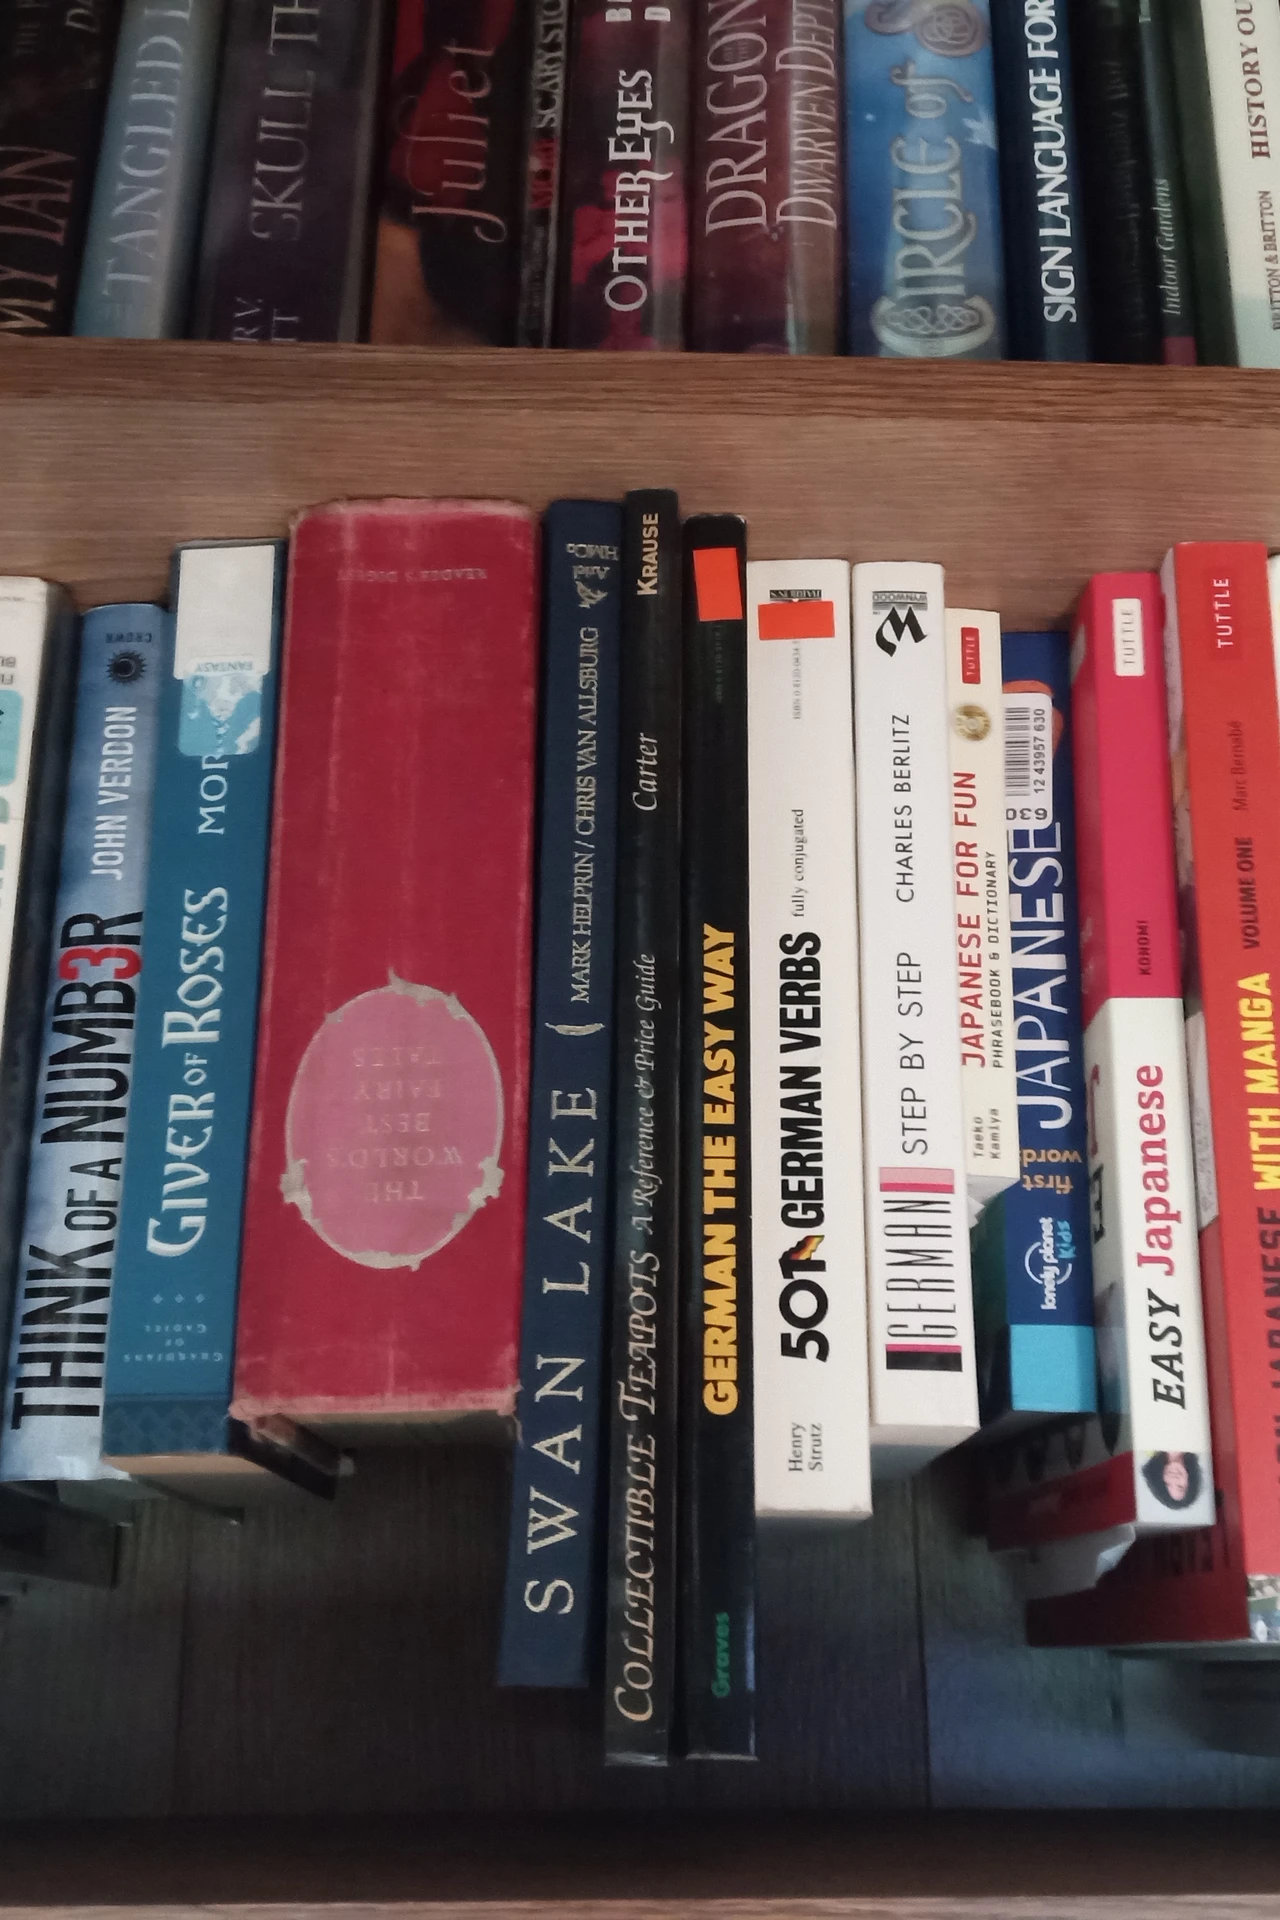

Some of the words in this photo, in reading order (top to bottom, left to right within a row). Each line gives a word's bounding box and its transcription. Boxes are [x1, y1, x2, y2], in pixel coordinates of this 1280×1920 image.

[1023, 0, 1060, 60] FOR
[1234, 0, 1259, 37] OU
[607, 69, 675, 163] EYES
[888, 58, 974, 120] of
[1240, 41, 1272, 160] HISTORY
[102, 35, 184, 296] TANGLED
[251, 69, 317, 241] SKULL
[402, 44, 507, 243] Juliet
[775, 80, 838, 230] DWARVEN
[1028, 67, 1072, 238] LANGUAGE
[604, 171, 674, 312] OTHER
[869, 134, 997, 358] CIRCLE
[1152, 178, 1176, 252] Gardens
[1257, 190, 1279, 251] BRITTON
[1040, 245, 1077, 323] SIGN
[1160, 255, 1182, 317] Indoor
[1263, 254, 1278, 265] &
[637, 512, 660, 596] KRAUSE
[1120, 609, 1137, 667] TUTTLE
[1212, 578, 1235, 650] TUTTLE
[193, 661, 254, 673] FANTASY
[577, 625, 601, 726] ALLSBURG
[97, 706, 138, 806] VERDON
[576, 730, 597, 773] VAN
[891, 713, 912, 793] BERLITZ
[1033, 708, 1046, 732] 630
[1033, 737, 1046, 776] 43957
[575, 775, 597, 836] CHRIS
[631, 732, 659, 812] Carter
[952, 771, 979, 828] FUN
[1034, 779, 1046, 794] 12
[1231, 776, 1249, 812] Marc
[90, 814, 128, 882] JOHN
[790, 808, 808, 882] conjugated
[893, 803, 915, 904] CHARLES
[954, 839, 980, 898] FOR
[1233, 836, 1256, 873] ONE
[572, 851, 595, 936] HELPRIN
[790, 886, 808, 918] fully
[984, 850, 999, 945] DICTIONARY
[1236, 876, 1261, 951] VOLUME
[161, 886, 229, 1049] ROSES
[570, 938, 592, 1004] MARK
[635, 952, 663, 1010] Guide
[703, 922, 735, 1015] WAY
[896, 951, 924, 1018] STEP
[1008, 822, 1074, 1130] JAPANESE
[1135, 919, 1152, 976] KONOMI
[40, 911, 144, 1144] NUMB3R
[778, 930, 823, 1055] VERBS
[956, 912, 986, 1069] JAPANESE
[989, 968, 1005, 1069] PHRASEBOOK
[182, 1052, 208, 1087] OF
[632, 1018, 656, 1072] Price
[898, 1032, 925, 1070] BY
[1236, 971, 1280, 1096] MANGA
[353, 1079, 442, 1100] FAIRY
[703, 1020, 736, 1125] EASY
[364, 1113, 432, 1135] BEST
[629, 1106, 663, 1208] Reference
[779, 1065, 826, 1229] GERMAN
[901, 1086, 929, 1156] STEP
[972, 1116, 985, 1159] Taeko
[989, 1108, 1002, 1160] Kamiya
[1246, 1107, 1280, 1191] WITH
[69, 1157, 123, 1182] A
[146, 1091, 216, 1257] GIVER
[371, 1181, 426, 1202] THE
[541, 1087, 599, 1296] LAKE
[703, 1135, 737, 1215] THE
[1022, 1174, 1074, 1195] first
[1136, 1064, 1183, 1277] Japanese
[64, 1188, 119, 1231] OF
[1038, 1216, 1059, 1264] planet
[882, 1199, 959, 1339] GERMAN
[1040, 1264, 1061, 1311] lonely
[11, 1239, 115, 1430] THINK
[617, 1249, 661, 1415] TEAPOTS
[703, 1223, 739, 1416] GERMAN
[778, 1256, 830, 1364] 501
[1146, 1287, 1187, 1410] EASY
[523, 1353, 587, 1615] SWAN
[787, 1420, 807, 1473] Henry
[807, 1422, 823, 1472] Strutz
[614, 1434, 656, 1723] COLLECTIBLE
[711, 1611, 730, 1698] Graves
